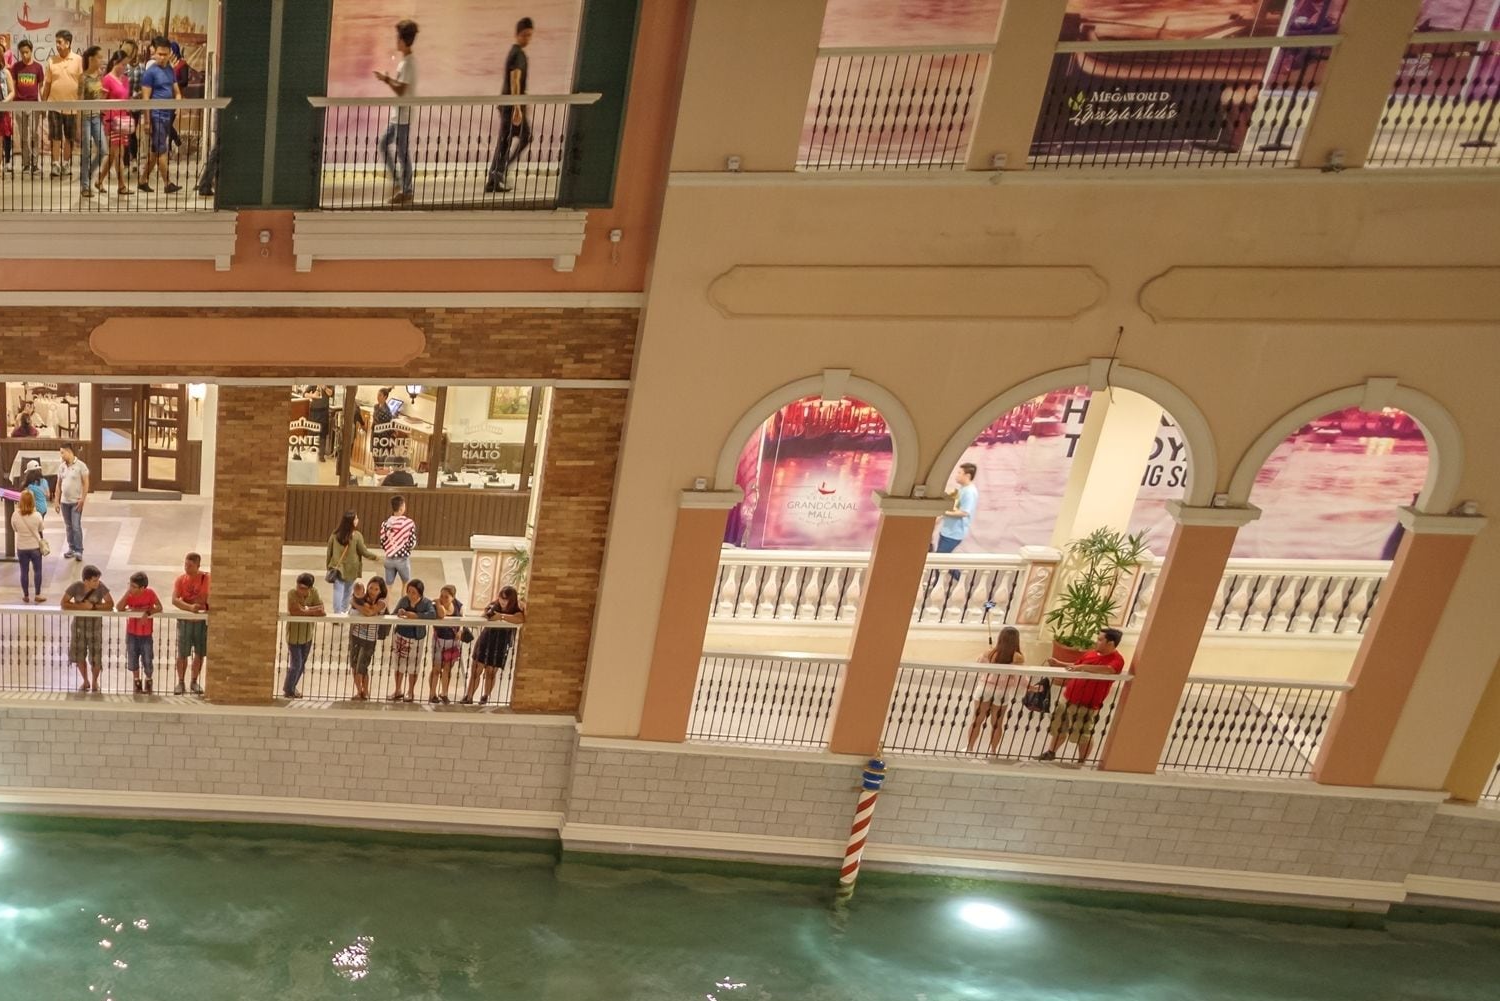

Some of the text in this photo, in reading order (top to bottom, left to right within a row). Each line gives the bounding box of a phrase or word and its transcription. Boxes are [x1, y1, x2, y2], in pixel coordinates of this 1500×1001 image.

[373, 437, 412, 447] PONTE
[463, 440, 501, 450] PONTE
[462, 450, 501, 460] RIALTO
[786, 501, 859, 511] GRANDCANAL
[807, 511, 833, 520] MALL
